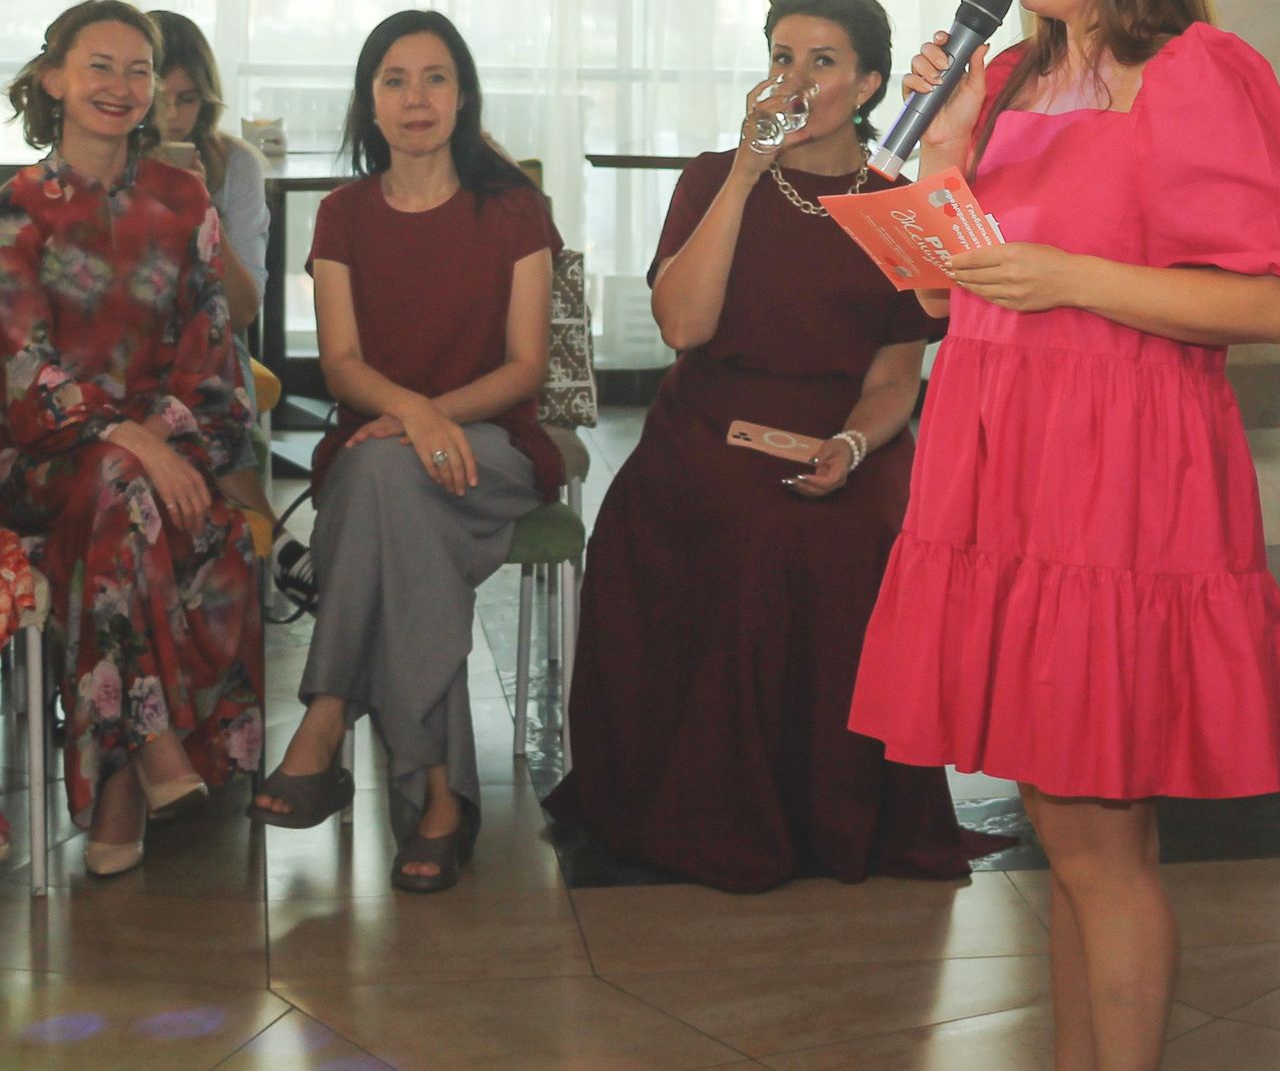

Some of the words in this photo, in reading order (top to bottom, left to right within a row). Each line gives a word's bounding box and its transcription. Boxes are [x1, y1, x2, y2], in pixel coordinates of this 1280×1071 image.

[890, 209, 954, 279] Женщи
[924, 236, 952, 262] PR
[952, 224, 971, 250] форум
